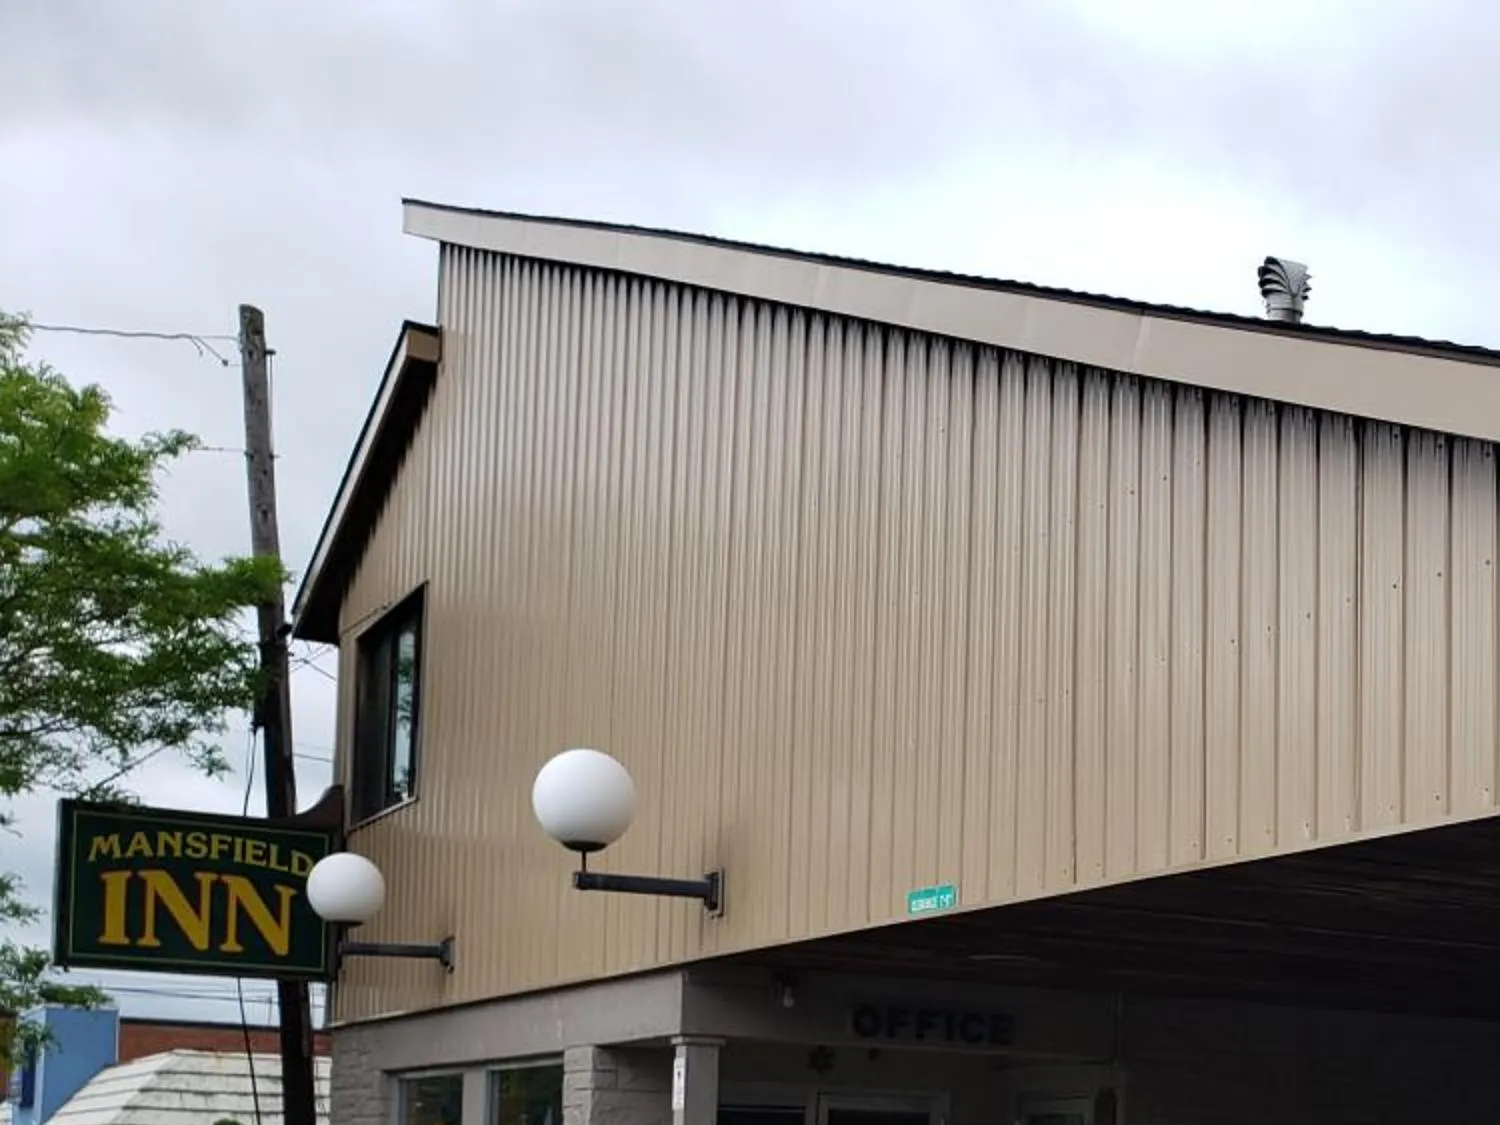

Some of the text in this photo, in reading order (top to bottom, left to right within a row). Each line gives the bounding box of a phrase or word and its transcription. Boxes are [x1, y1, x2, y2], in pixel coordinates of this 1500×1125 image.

[87, 831, 316, 878] MANSFIELD
[97, 868, 298, 957] INN
[851, 1003, 1014, 1046] OFFICE
